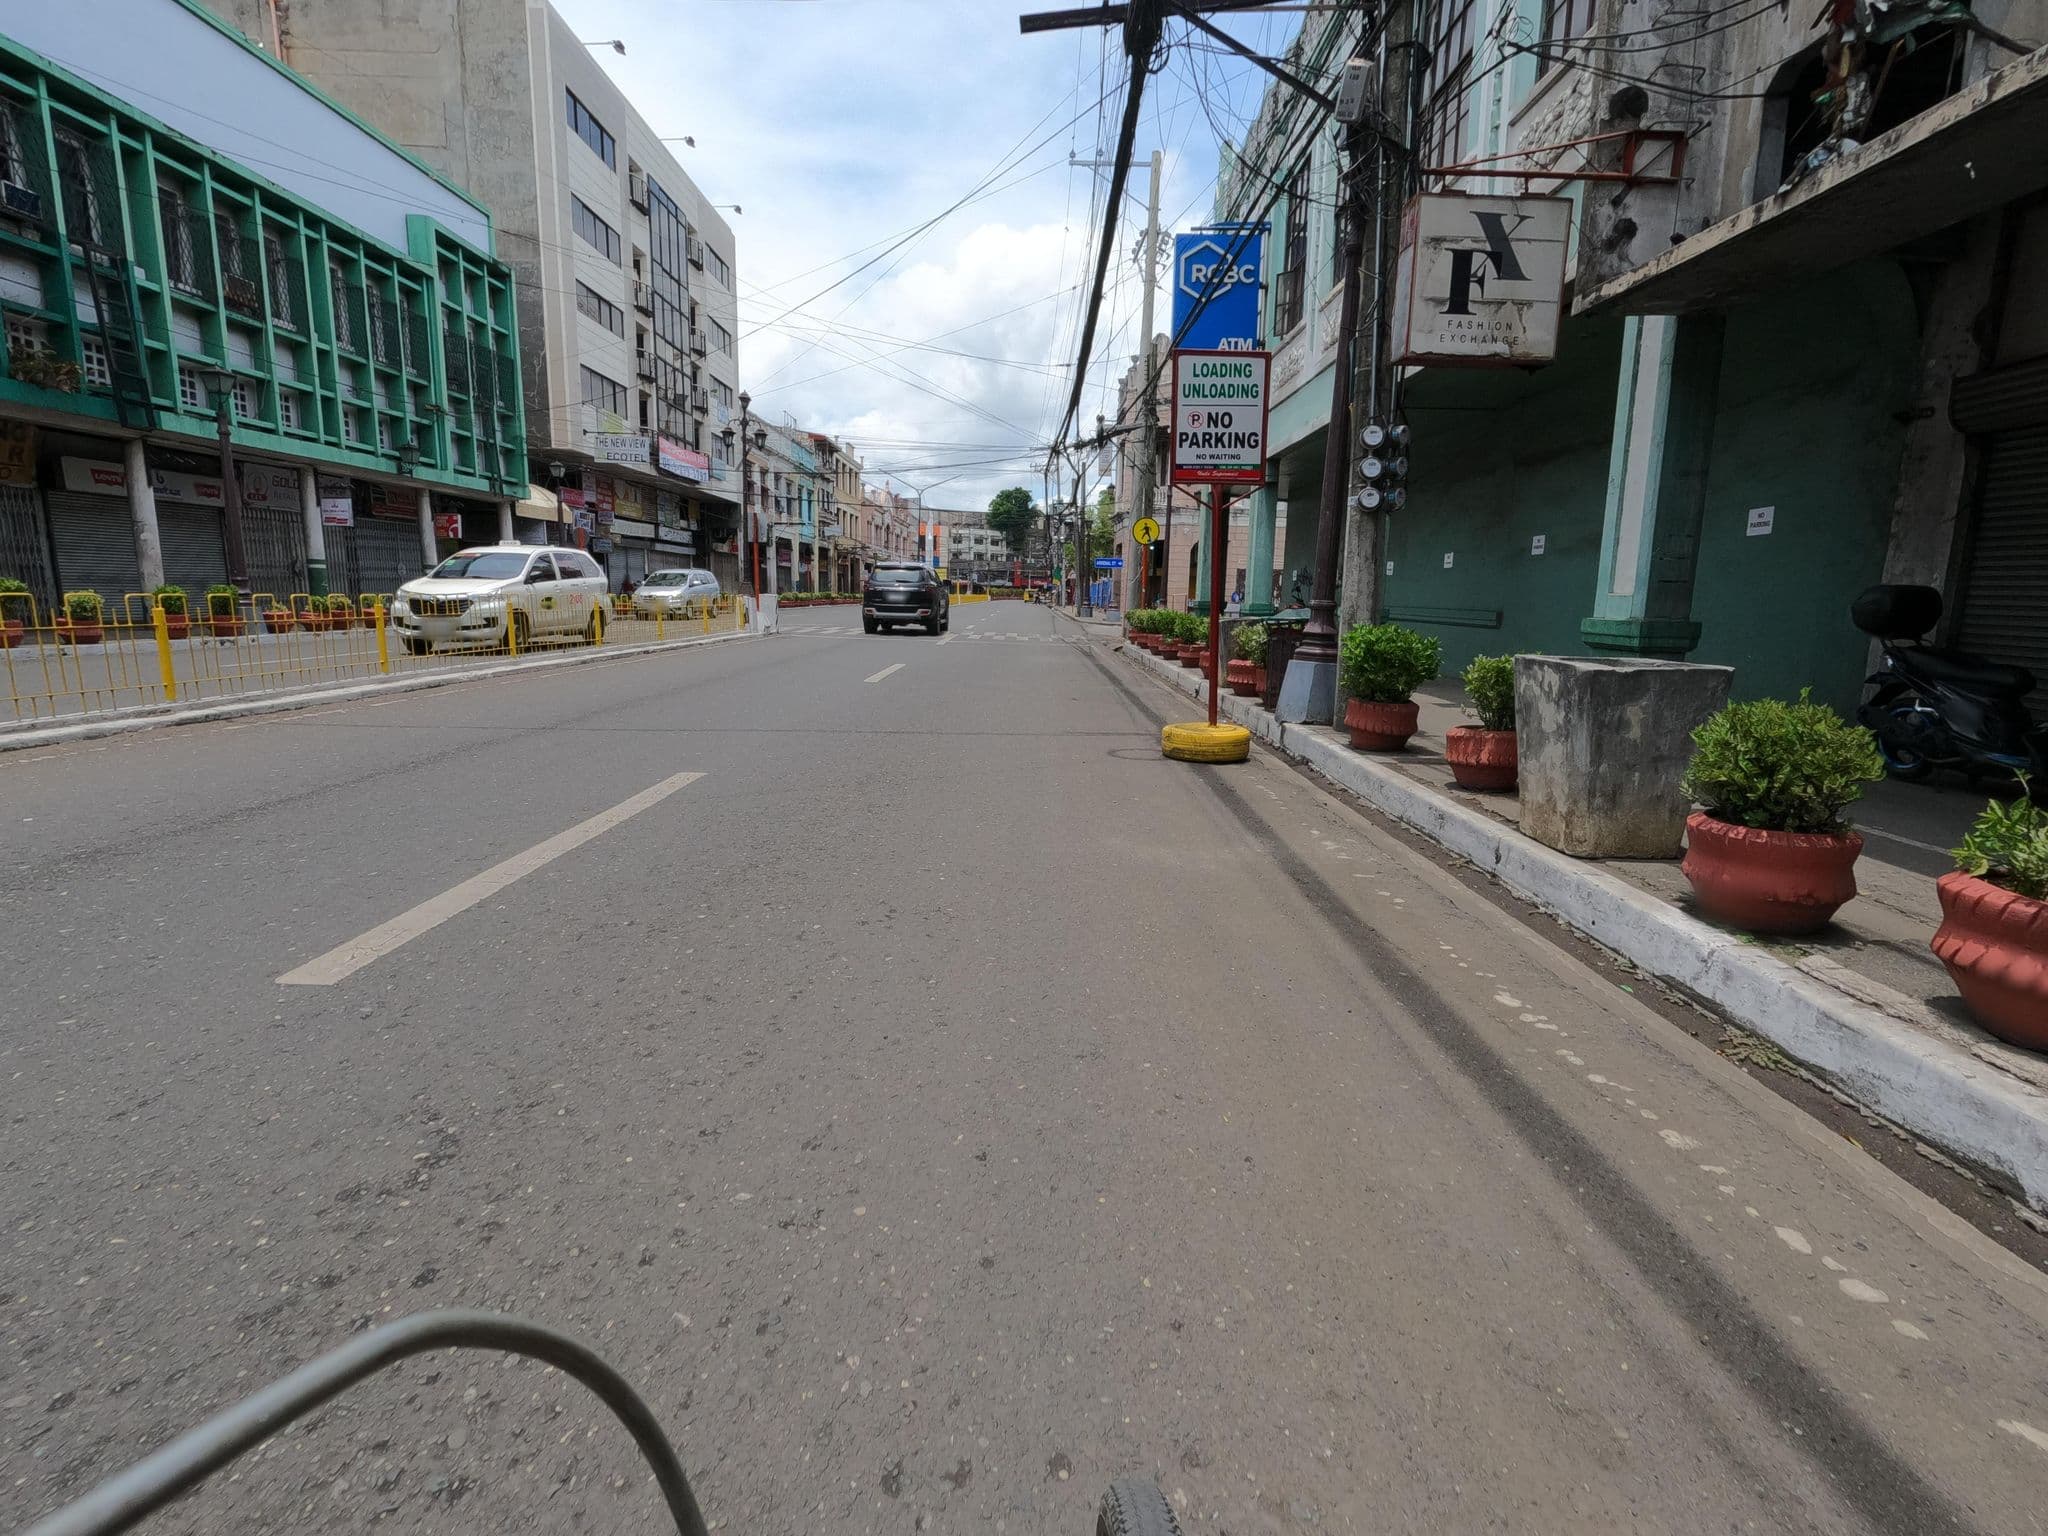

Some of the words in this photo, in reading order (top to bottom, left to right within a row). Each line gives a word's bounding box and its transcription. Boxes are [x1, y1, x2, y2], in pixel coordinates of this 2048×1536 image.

[1191, 264, 1255, 284] RCBC
[1447, 320, 1513, 331] FASHION
[1218, 337, 1253, 351] ATM
[1439, 333, 1520, 346] EXCHANGE
[1193, 363, 1253, 378] LOADING
[1182, 383, 1259, 399] UNLOADING
[1207, 411, 1233, 429] NO
[595, 437, 609, 448] THE
[610, 438, 626, 448] NEW
[628, 438, 646, 449] VIEW
[1178, 432, 1259, 449] PARKING
